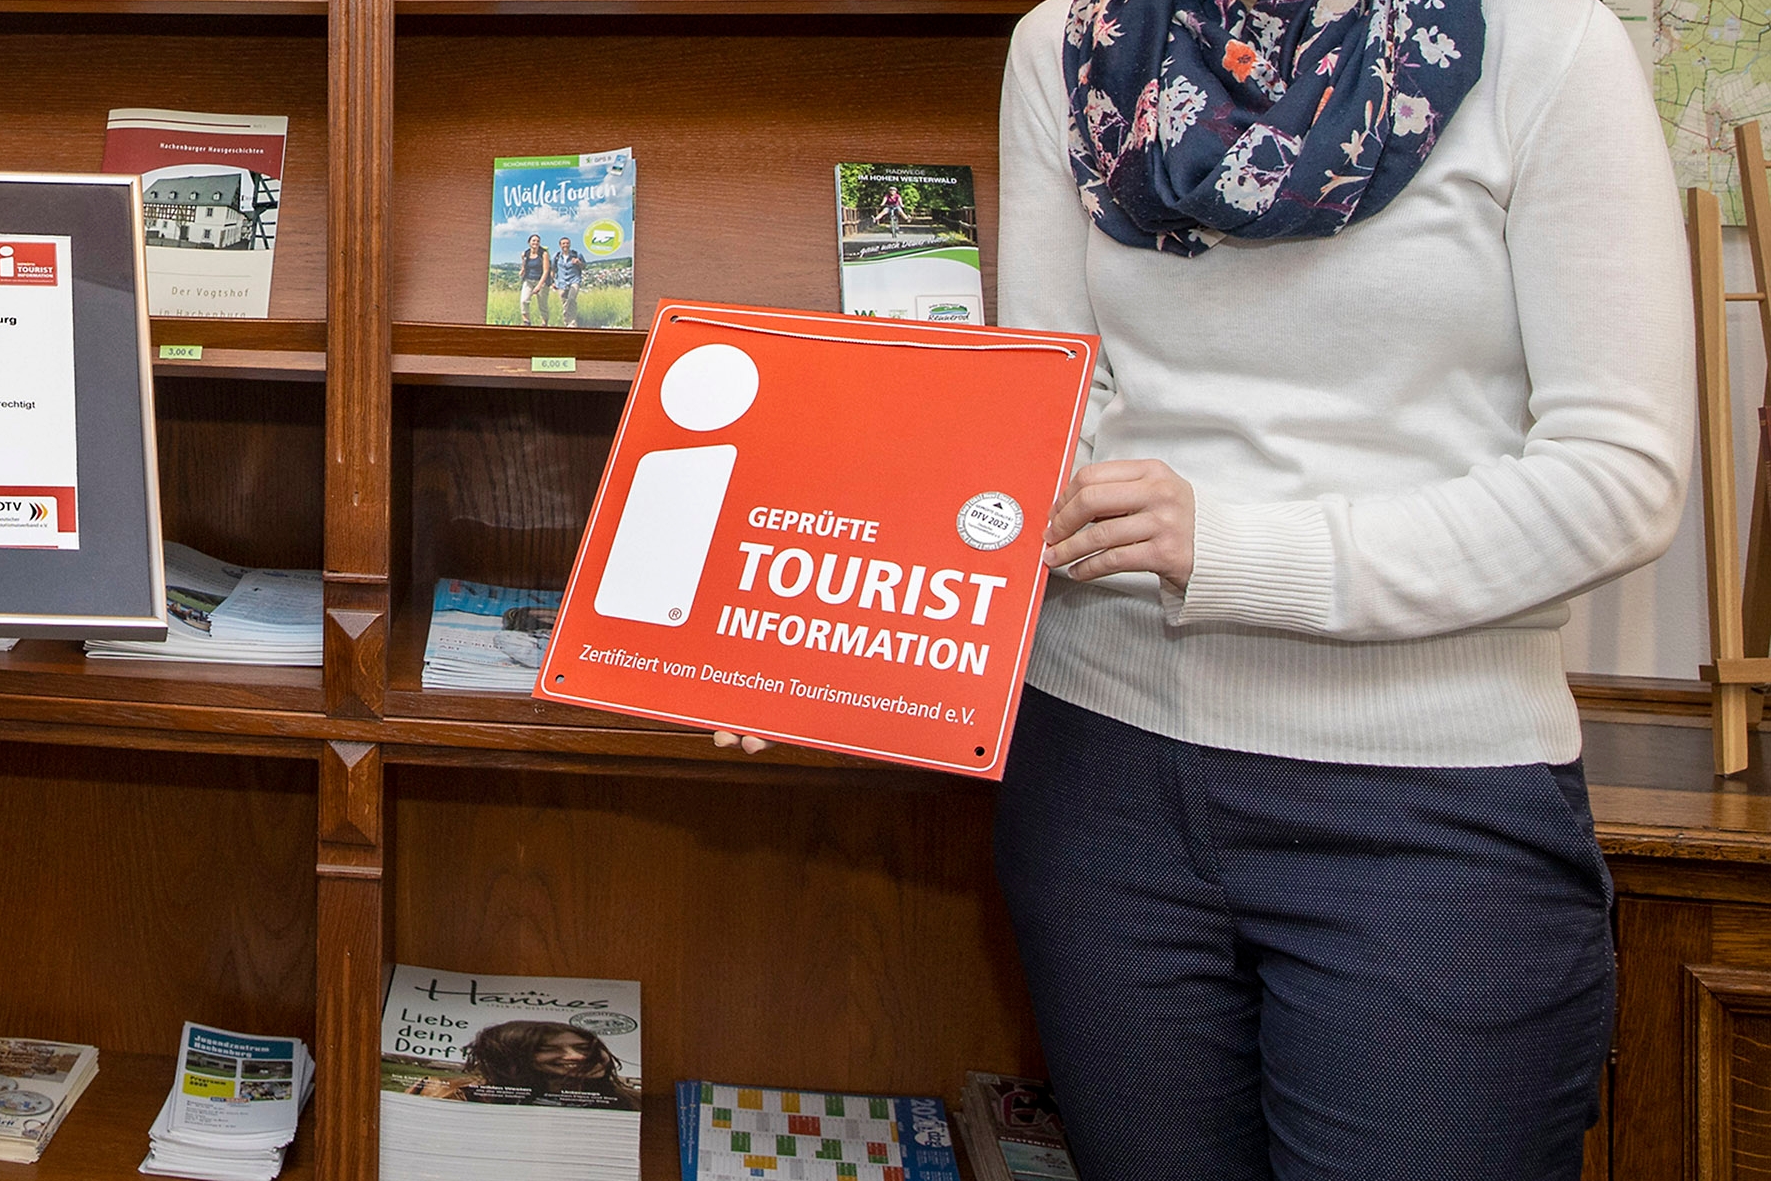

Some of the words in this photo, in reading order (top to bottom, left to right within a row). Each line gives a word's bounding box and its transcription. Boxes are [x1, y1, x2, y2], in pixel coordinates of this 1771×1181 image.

[159, 142, 206, 153] Hachenburger
[208, 146, 264, 155] Hausgeschichten
[900, 175, 958, 184] WESTERWALD
[171, 286, 191, 296] Der
[196, 287, 250, 299] Vogtshof
[168, 348, 187, 356] 3,00
[187, 348, 194, 356] €
[541, 360, 561, 368] 6,00
[562, 359, 569, 368] €
[747, 505, 880, 544] GEPRÜFTE
[970, 509, 989, 522] DTV
[988, 516, 1009, 531] 2023
[737, 541, 1008, 627] TOURIST
[715, 604, 991, 677] INFORMATION
[578, 643, 660, 674] Zertifiziert
[662, 661, 697, 680] vom
[699, 663, 786, 695] Deutschen
[789, 677, 942, 722] Tourismusverband
[944, 704, 976, 727] e.V.
[414, 978, 609, 1010] Hannes
[401, 1008, 469, 1030] Liebe
[398, 1025, 453, 1043] dein
[193, 1042, 253, 1059] Hachenburg
[194, 1035, 271, 1053] Jugendzentrum
